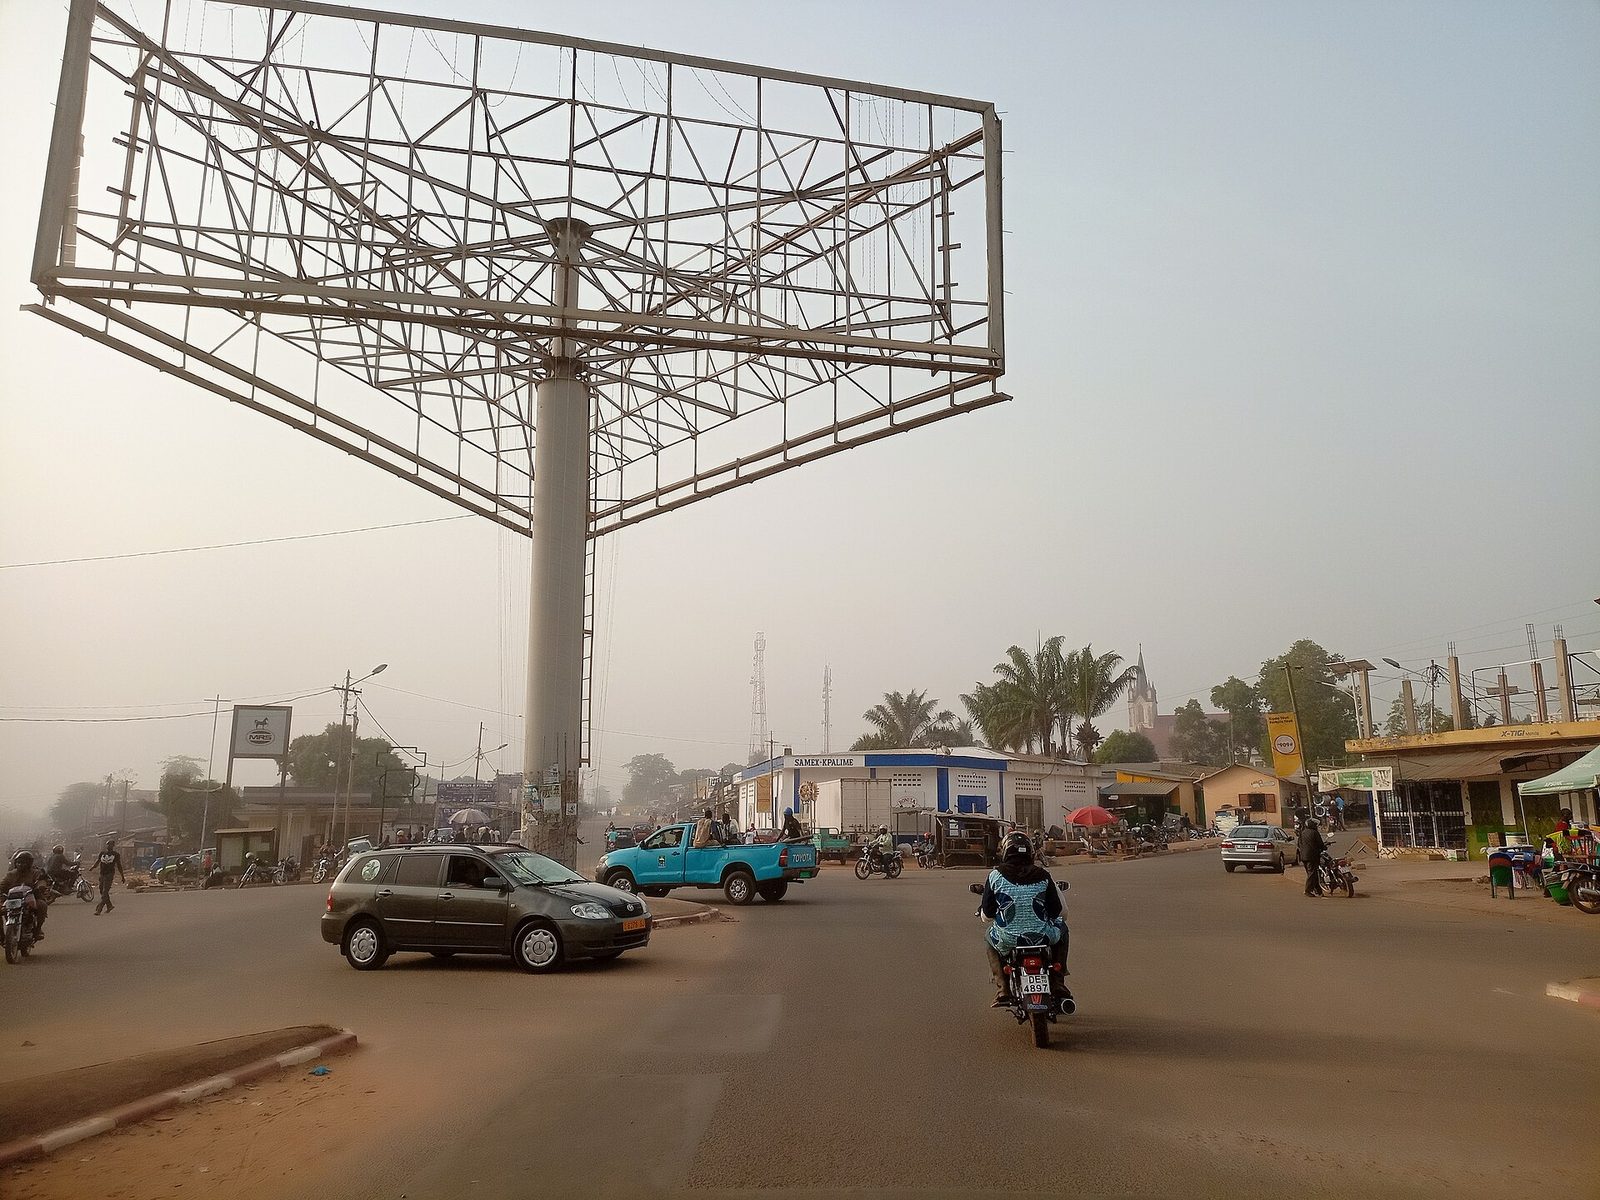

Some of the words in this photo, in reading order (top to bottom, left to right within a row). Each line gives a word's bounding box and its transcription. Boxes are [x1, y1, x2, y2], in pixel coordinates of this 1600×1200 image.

[1501, 730, 1525, 738] X-TIGI
[794, 758, 854, 767] SAMEX-KPALIME
[792, 853, 812, 863] TOYOTA
[1028, 975, 1041, 984] DE
[1024, 984, 1048, 992] 4897
